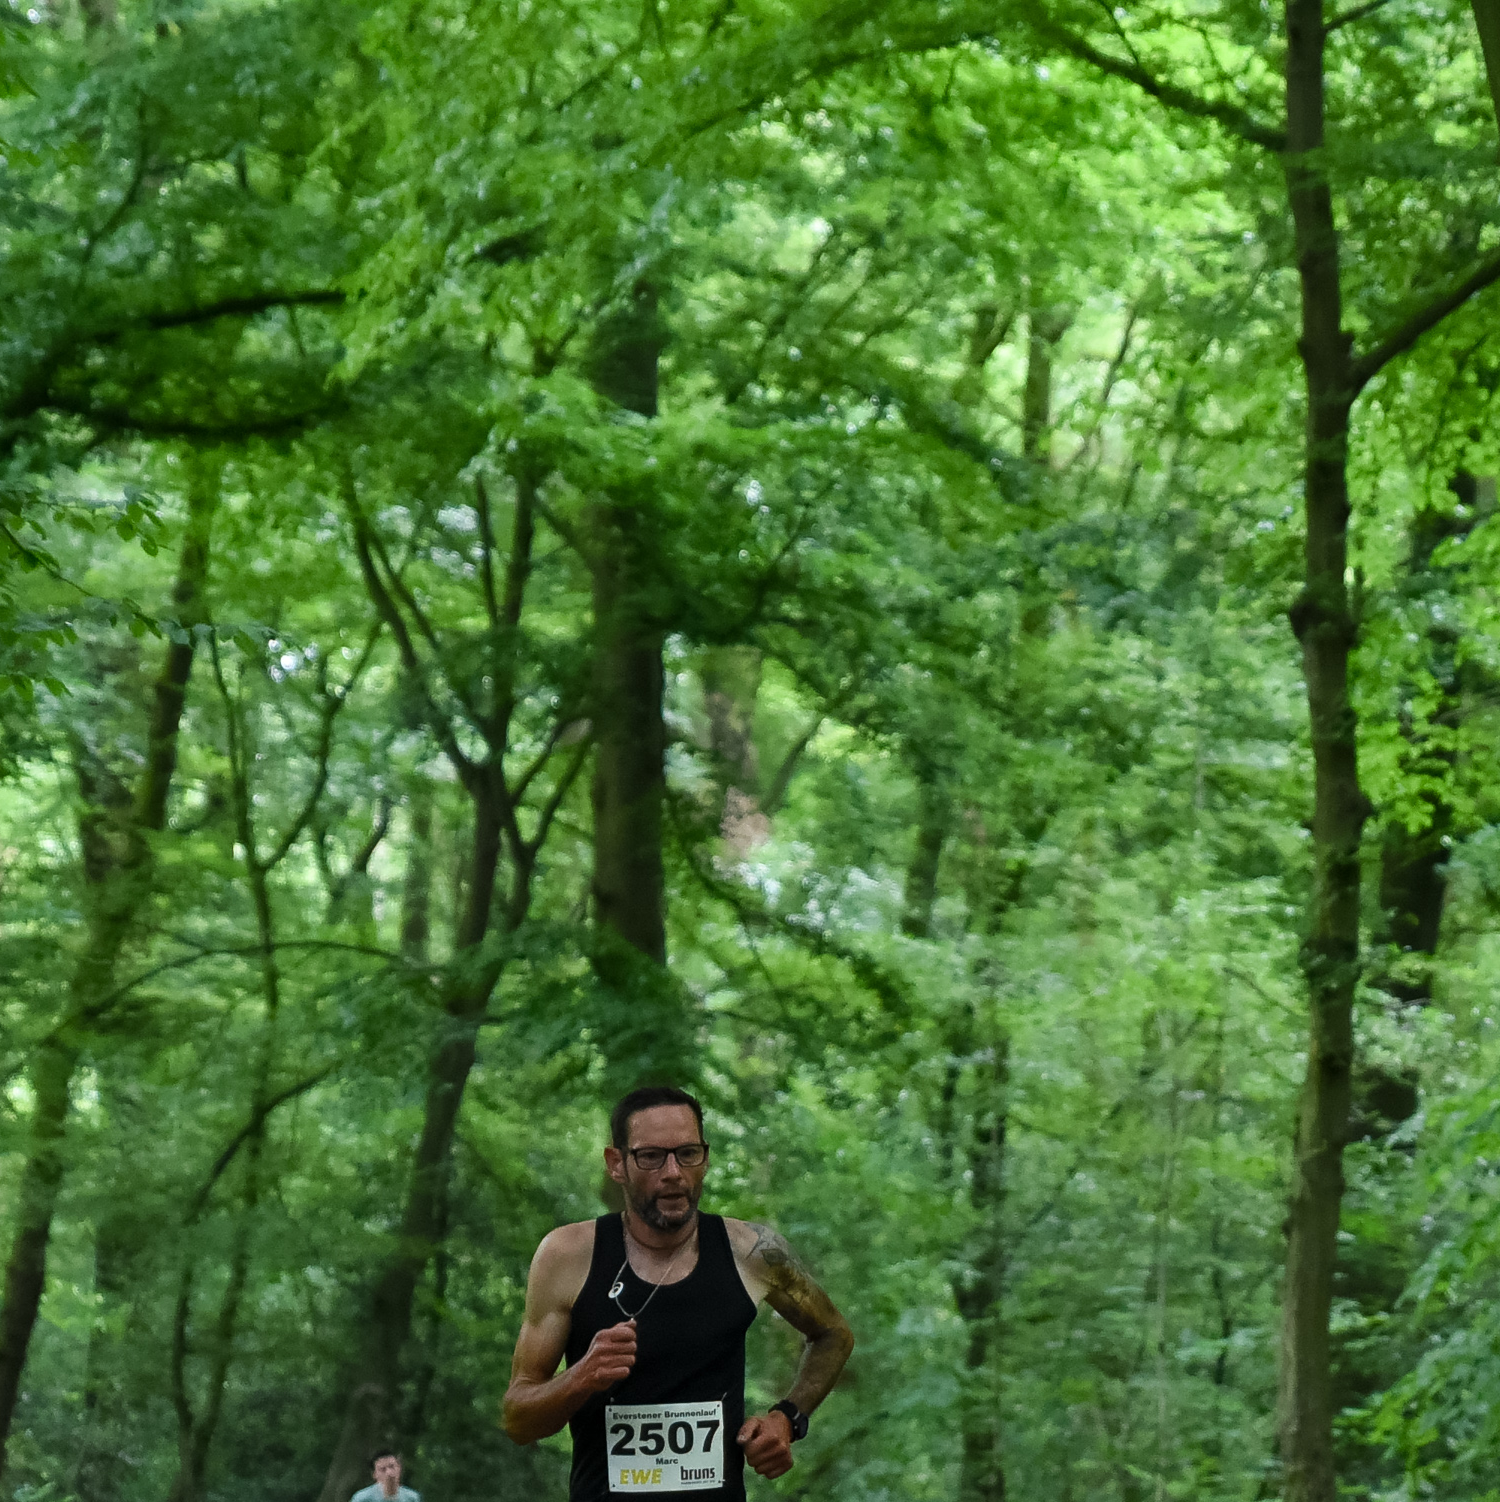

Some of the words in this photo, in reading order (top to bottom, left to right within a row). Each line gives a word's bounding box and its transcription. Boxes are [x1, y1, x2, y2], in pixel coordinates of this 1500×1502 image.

[613, 1412, 662, 1420] Everstener
[664, 1409, 716, 1418] Brunnenlauf
[610, 1420, 720, 1456] 2507
[620, 1468, 663, 1485] EWE
[680, 1466, 716, 1481] bruns
